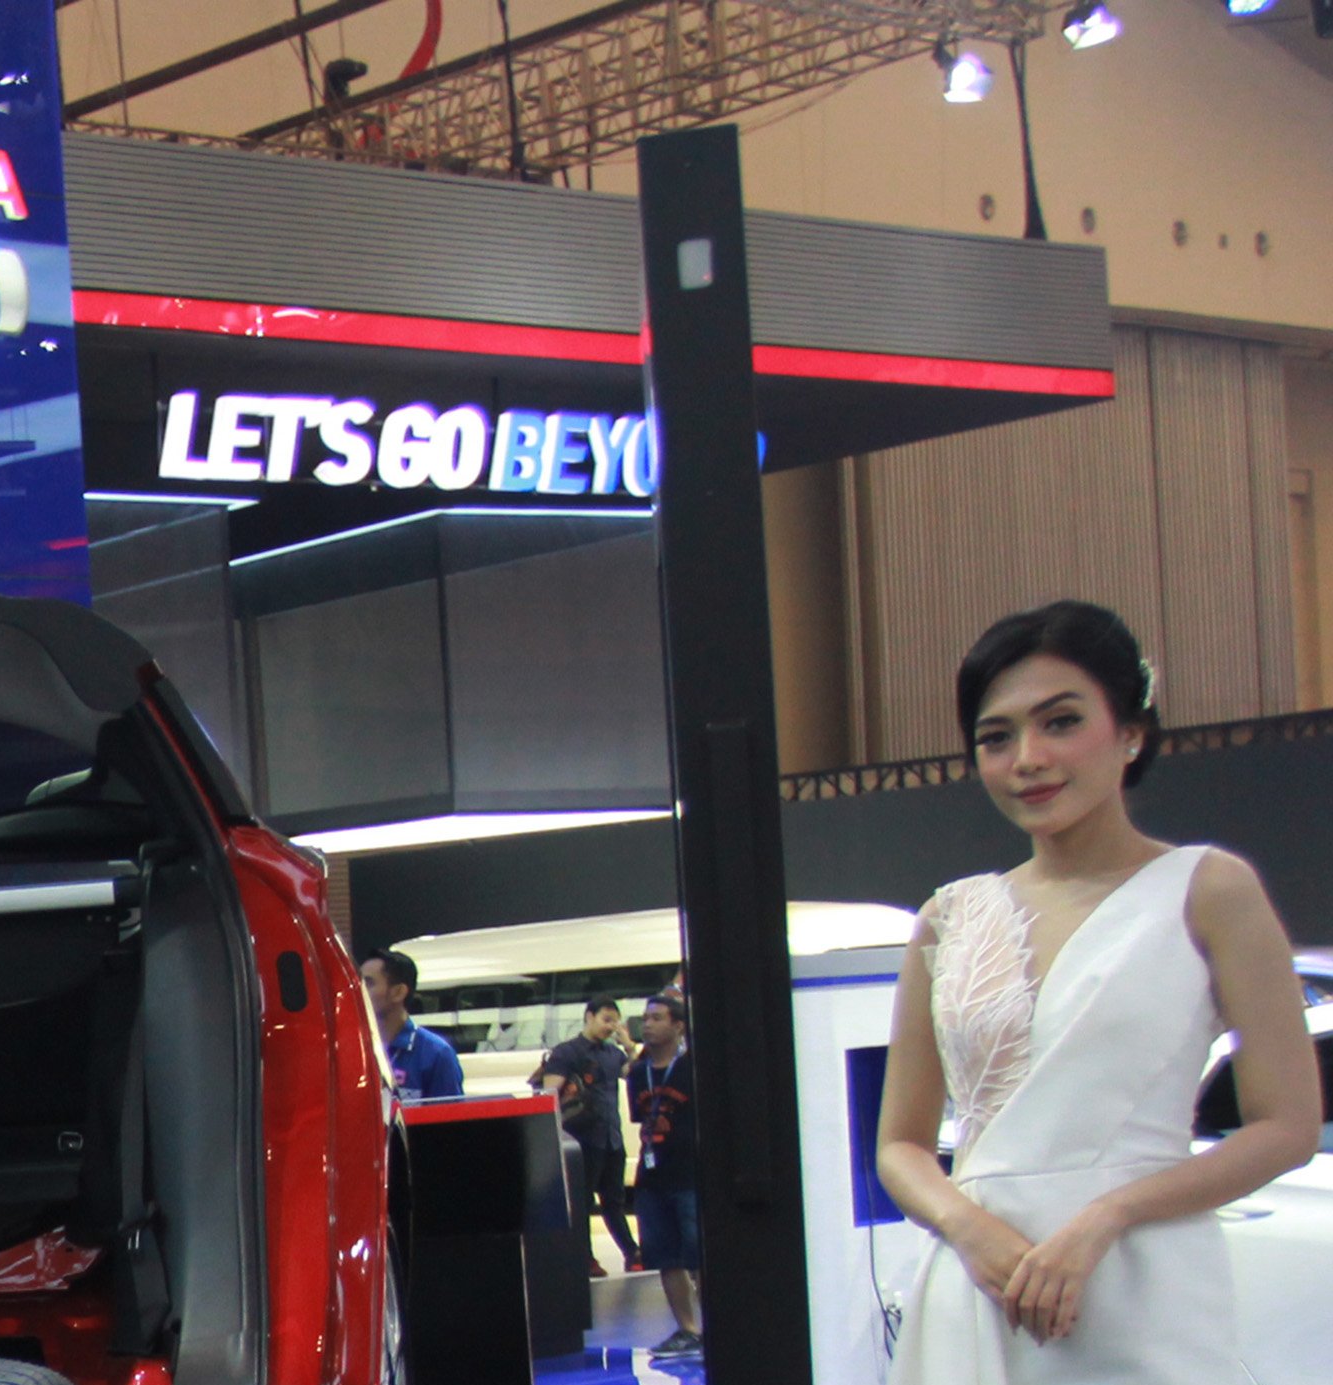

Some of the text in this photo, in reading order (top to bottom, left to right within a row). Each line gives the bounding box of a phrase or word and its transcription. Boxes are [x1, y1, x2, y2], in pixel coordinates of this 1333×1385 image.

[158, 390, 663, 498] LET'S GO BEYO
